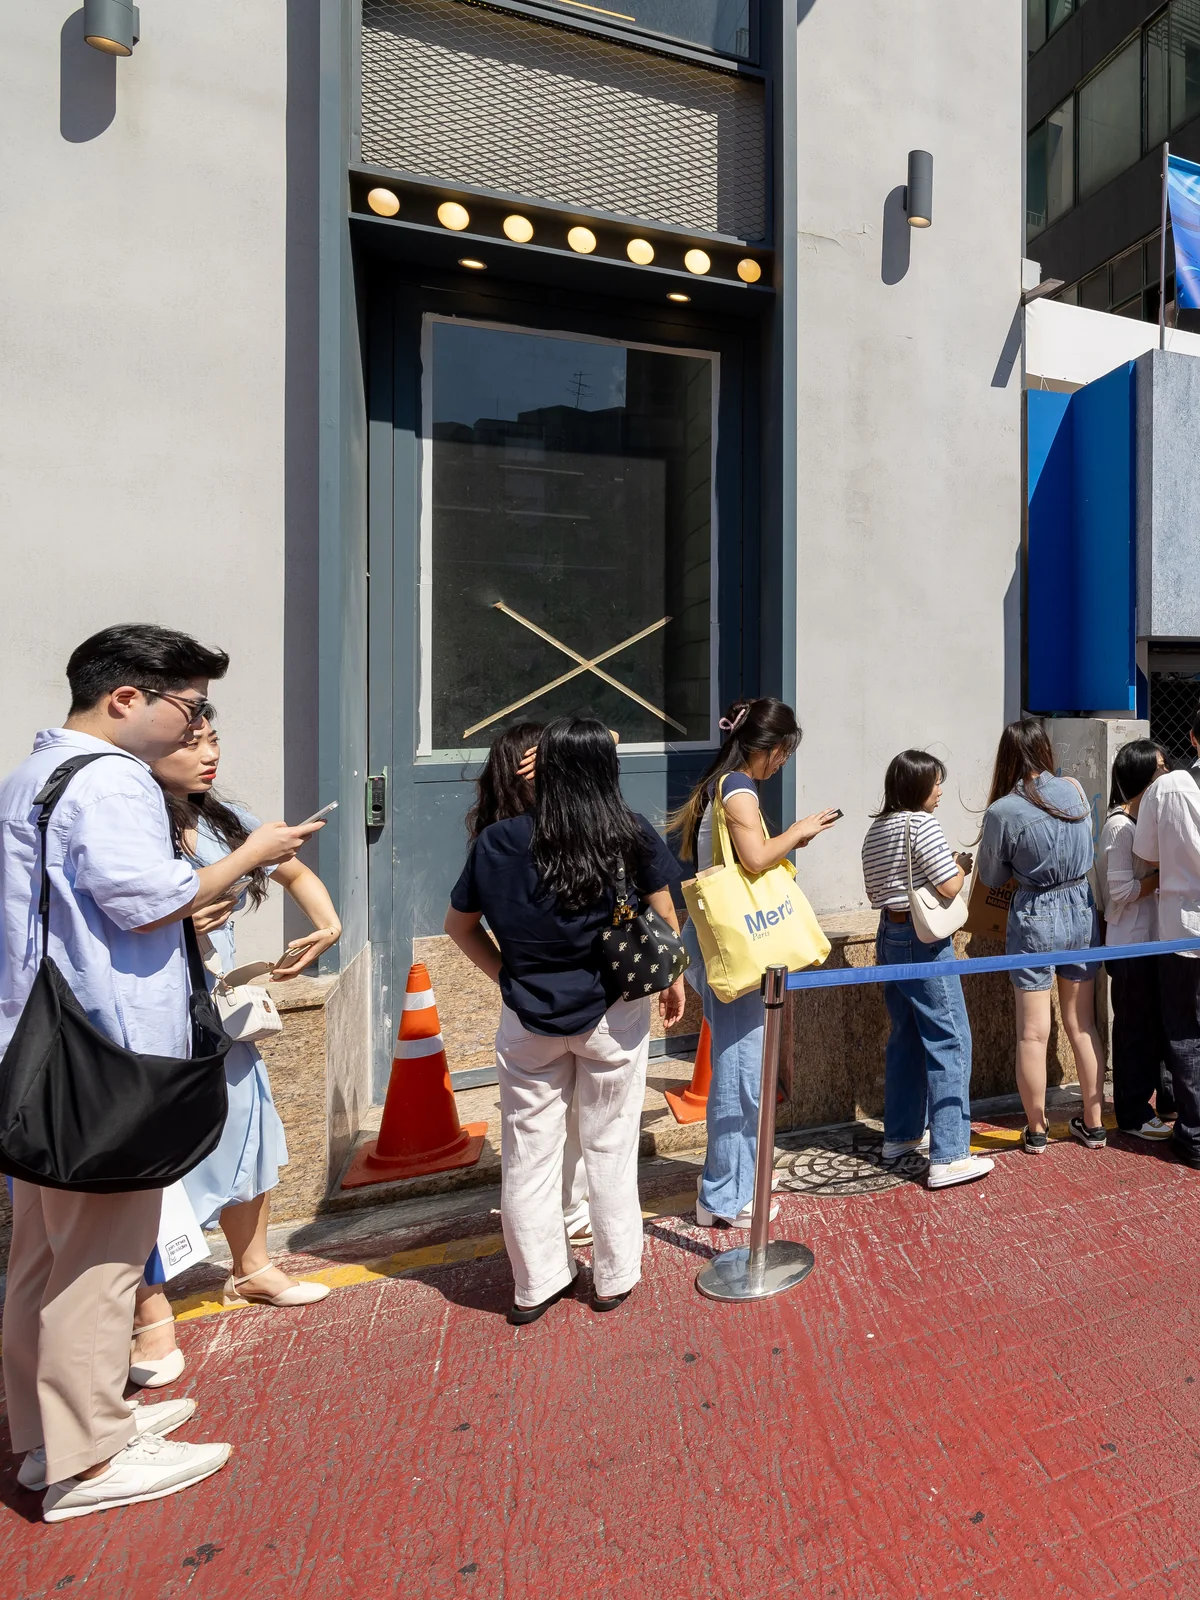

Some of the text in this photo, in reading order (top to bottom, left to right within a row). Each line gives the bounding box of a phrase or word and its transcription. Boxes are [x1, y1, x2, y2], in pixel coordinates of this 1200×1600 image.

[989, 887, 1012, 901] SHO
[987, 897, 1010, 909] MARK
[744, 895, 793, 934] Merci
[752, 930, 770, 941] Paris
